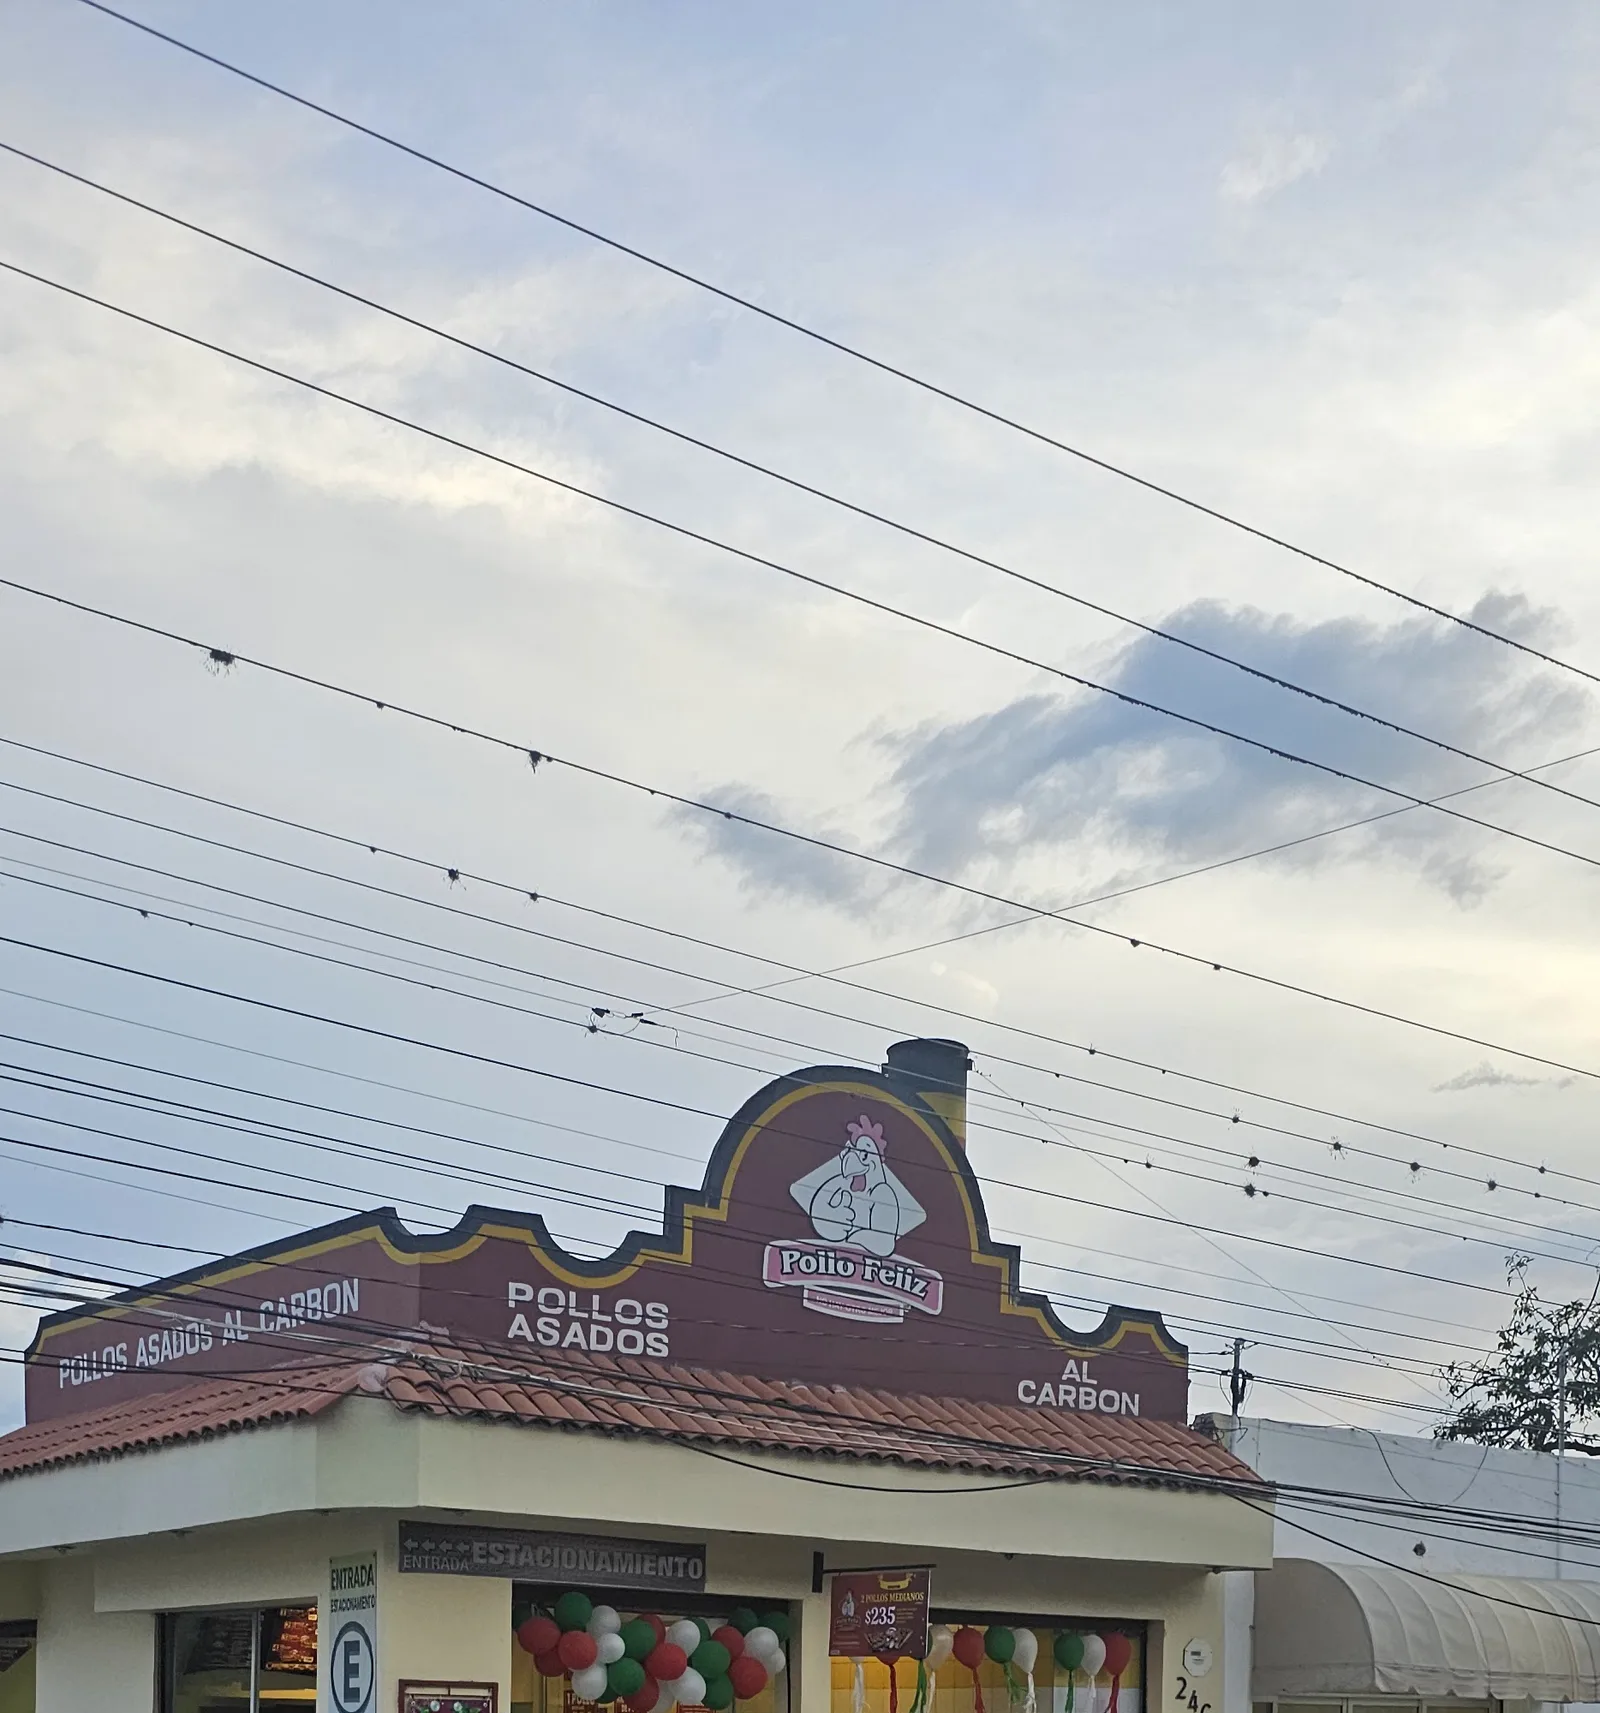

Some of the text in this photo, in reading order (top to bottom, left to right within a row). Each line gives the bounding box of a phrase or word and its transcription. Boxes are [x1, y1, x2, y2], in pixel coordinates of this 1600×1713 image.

[780, 1250, 928, 1300] Pollo Feliz
[508, 1282, 669, 1330] POLLOS
[59, 1278, 360, 1388] POLLOS ASADOS AL CARBON
[507, 1317, 669, 1358] ASADOS
[1061, 1359, 1098, 1384] AL
[1018, 1380, 1140, 1417] CARBON
[331, 1564, 375, 1591] ENTRADA
[403, 1541, 704, 1580] ENTRADA ESTACIONAMIENTO
[865, 1606, 896, 1625] $235
[866, 1594, 888, 1603] POLLOS
[889, 1592, 925, 1602] MEDIANOS
[344, 1640, 360, 1703] E
